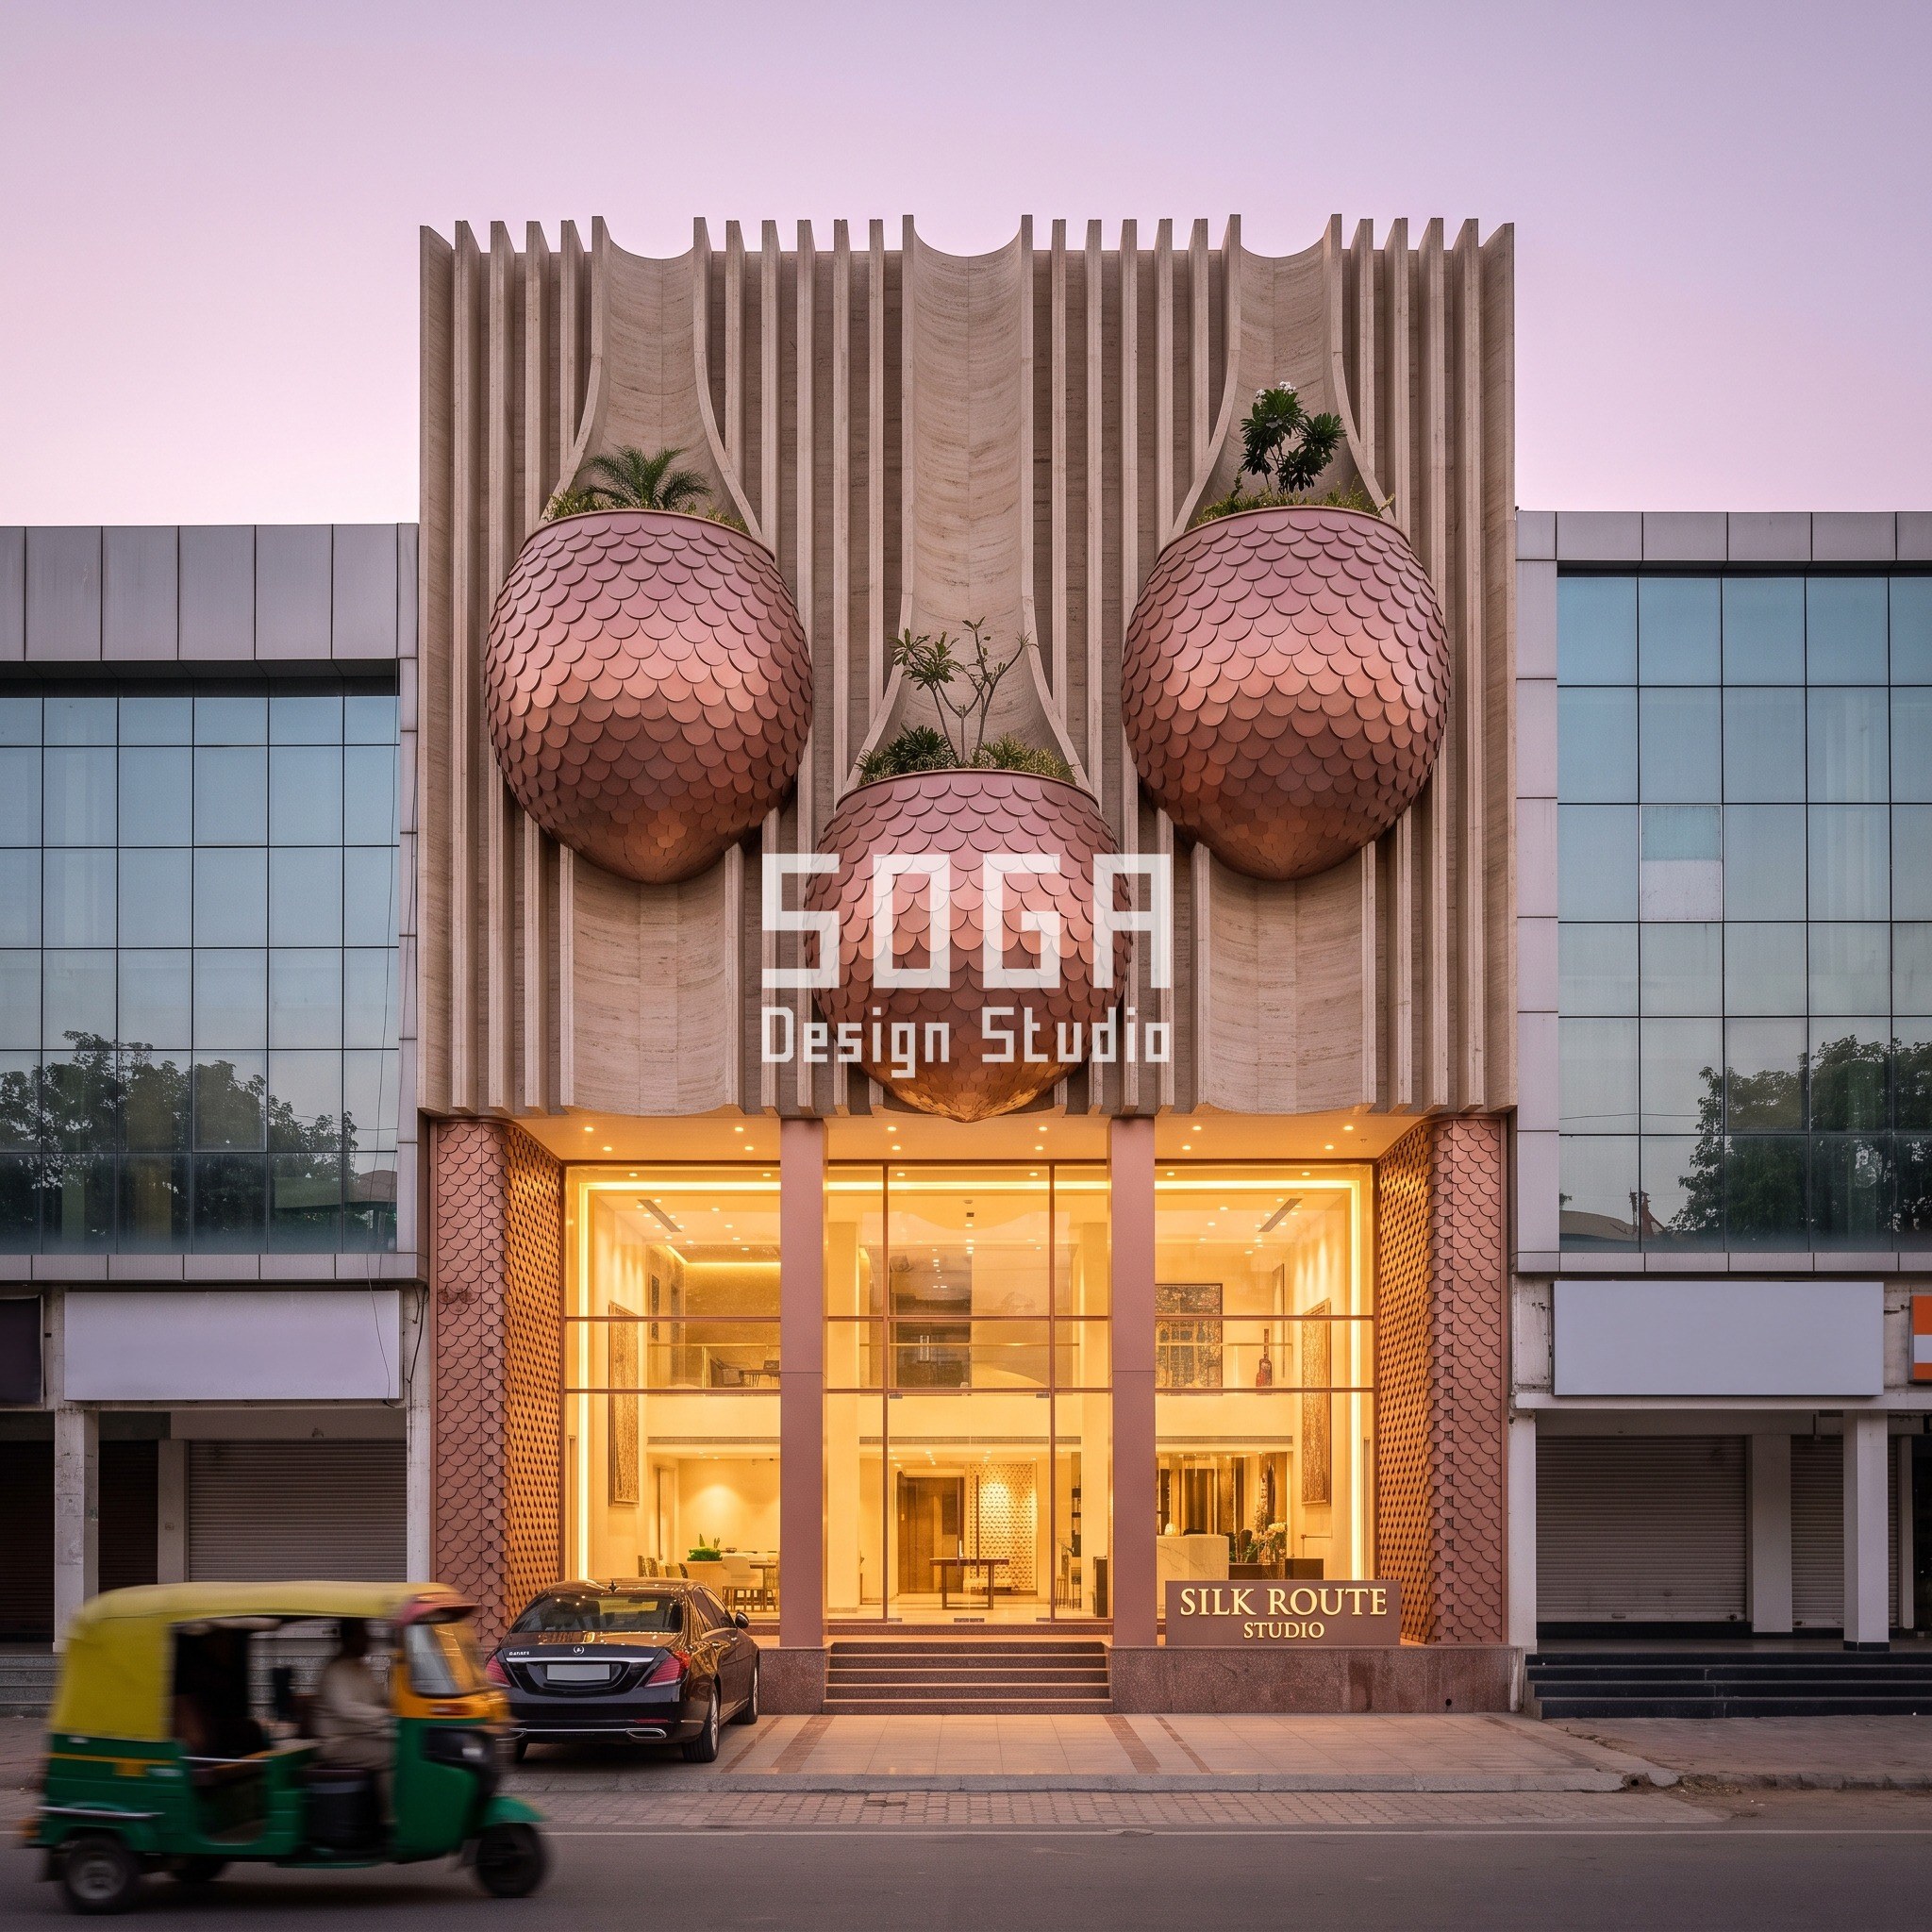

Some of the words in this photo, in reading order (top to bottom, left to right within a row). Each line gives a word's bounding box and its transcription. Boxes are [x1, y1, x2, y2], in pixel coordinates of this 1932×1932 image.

[1180, 1588, 1257, 1616] SILK
[1267, 1588, 1388, 1616] ROUTE
[1243, 1622, 1325, 1639] STUDIO
